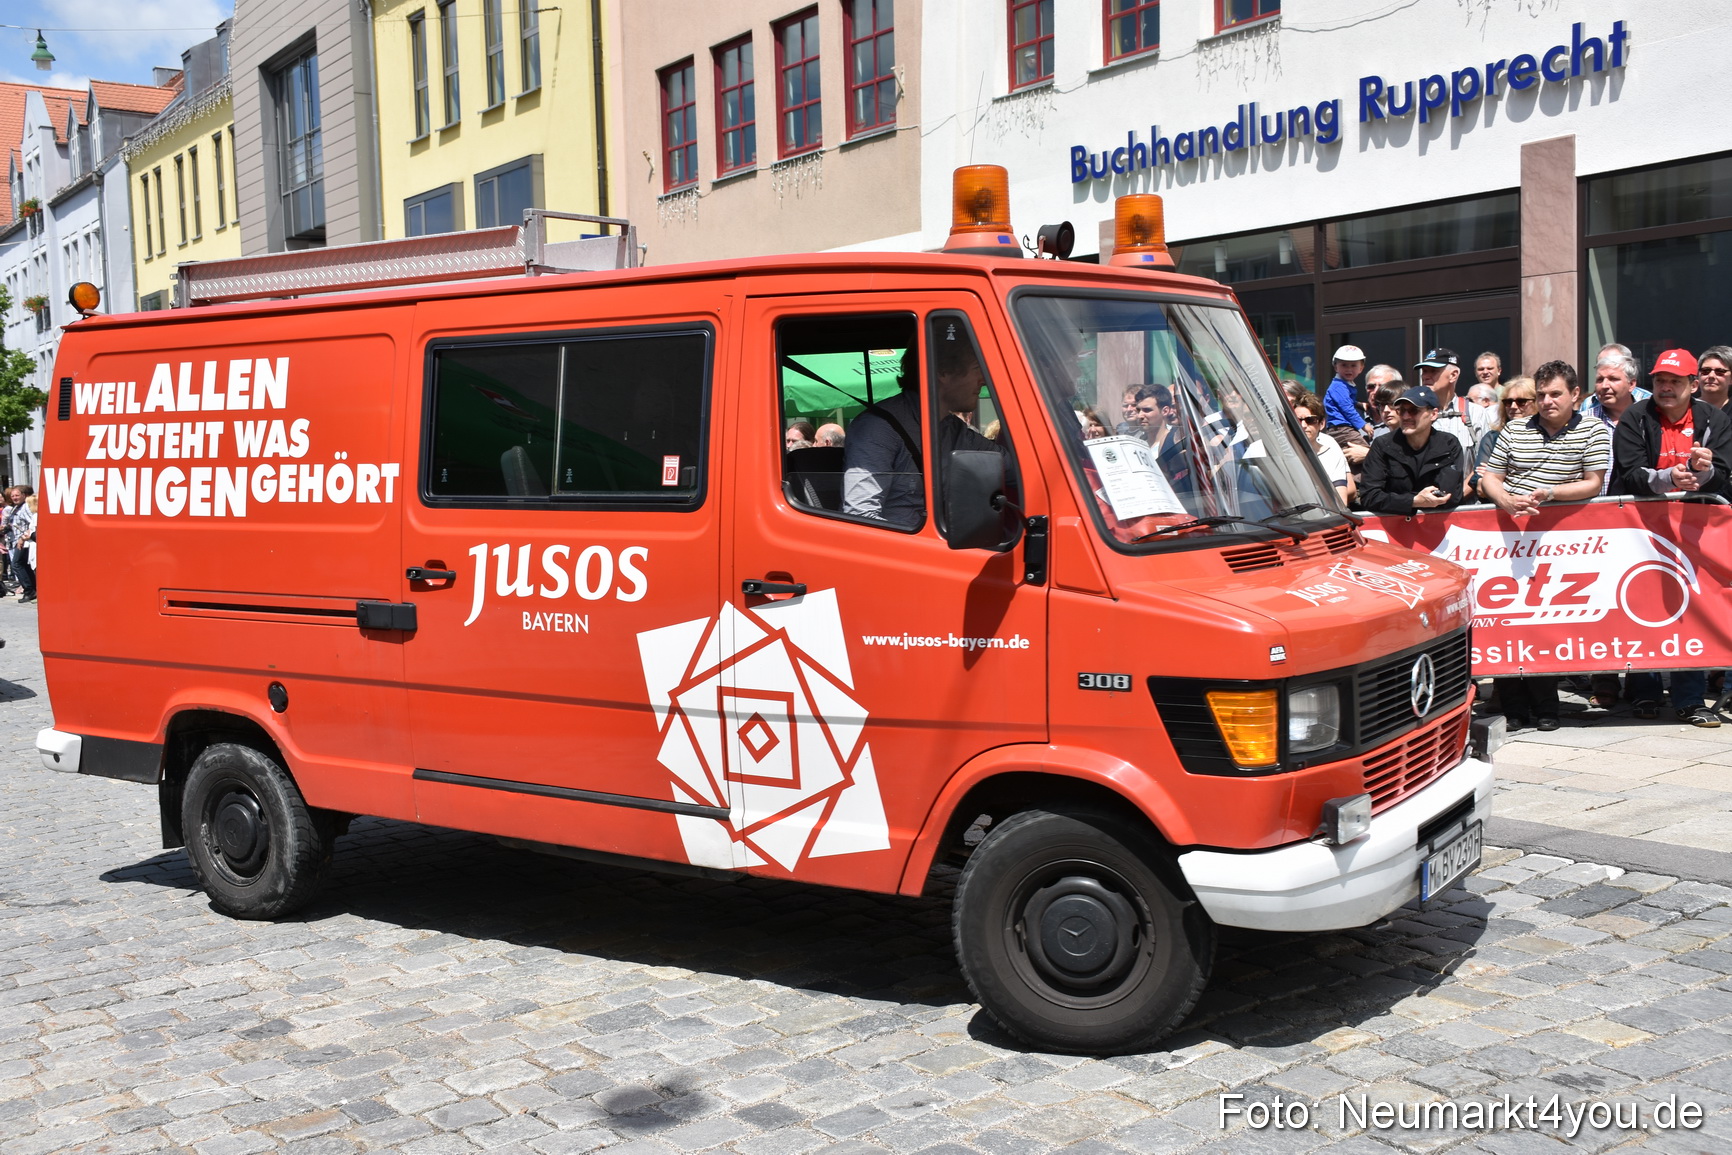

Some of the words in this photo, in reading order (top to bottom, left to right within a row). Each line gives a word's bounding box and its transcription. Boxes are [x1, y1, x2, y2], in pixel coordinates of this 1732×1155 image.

[1071, 99, 1340, 183] Buchhandlung
[1359, 20, 1629, 124] Rupprecht
[74, 381, 141, 415] WEIL
[143, 356, 290, 413] ALLEN
[86, 421, 225, 461] ZUSTEHT
[233, 417, 311, 459] WAS
[43, 465, 248, 518] WENIGEN
[250, 450, 400, 504] GEHÖRT
[1447, 535, 1610, 563] Autoklassik
[1467, 562, 1601, 610] etz
[522, 611, 589, 634] BAYERN
[861, 631, 1031, 652] www.jusos-bayern.de
[1079, 673, 1130, 690] 308
